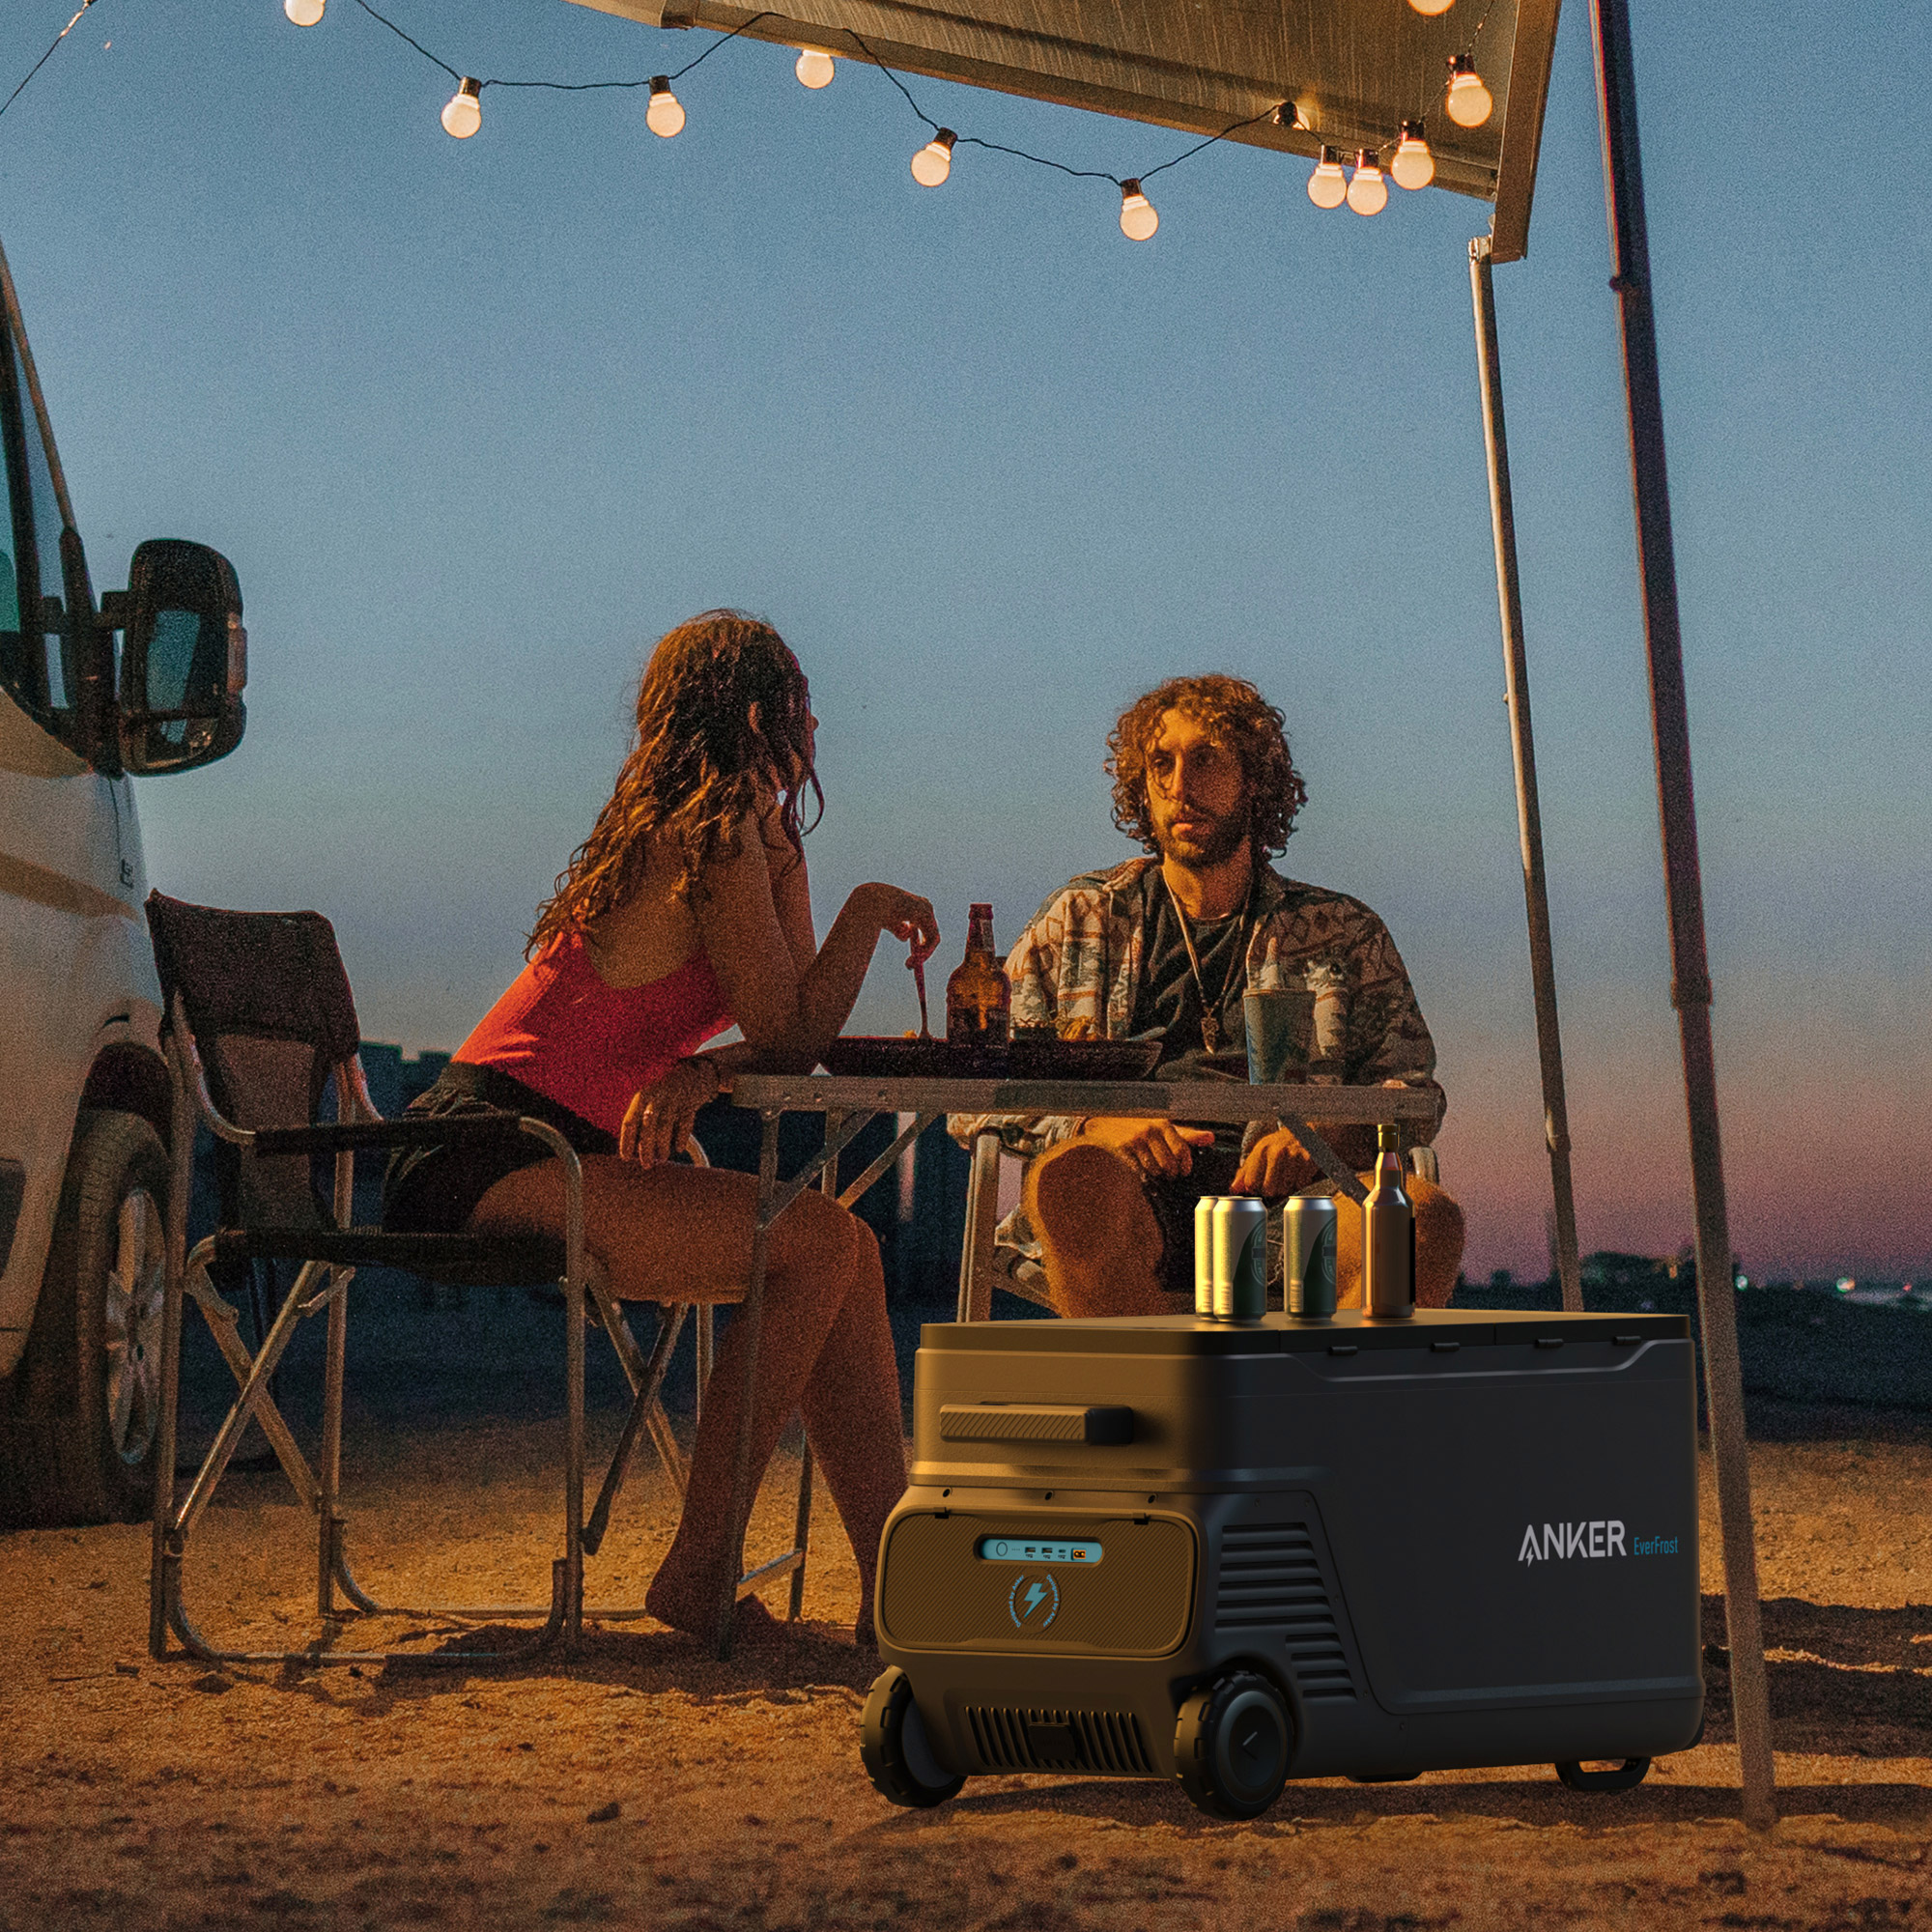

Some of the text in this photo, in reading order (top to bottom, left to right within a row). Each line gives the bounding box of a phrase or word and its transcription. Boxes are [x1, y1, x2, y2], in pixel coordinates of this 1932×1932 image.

[1518, 1520, 1679, 1567] ANKER EverFrost
[1046, 1574, 1059, 1601] Designed
